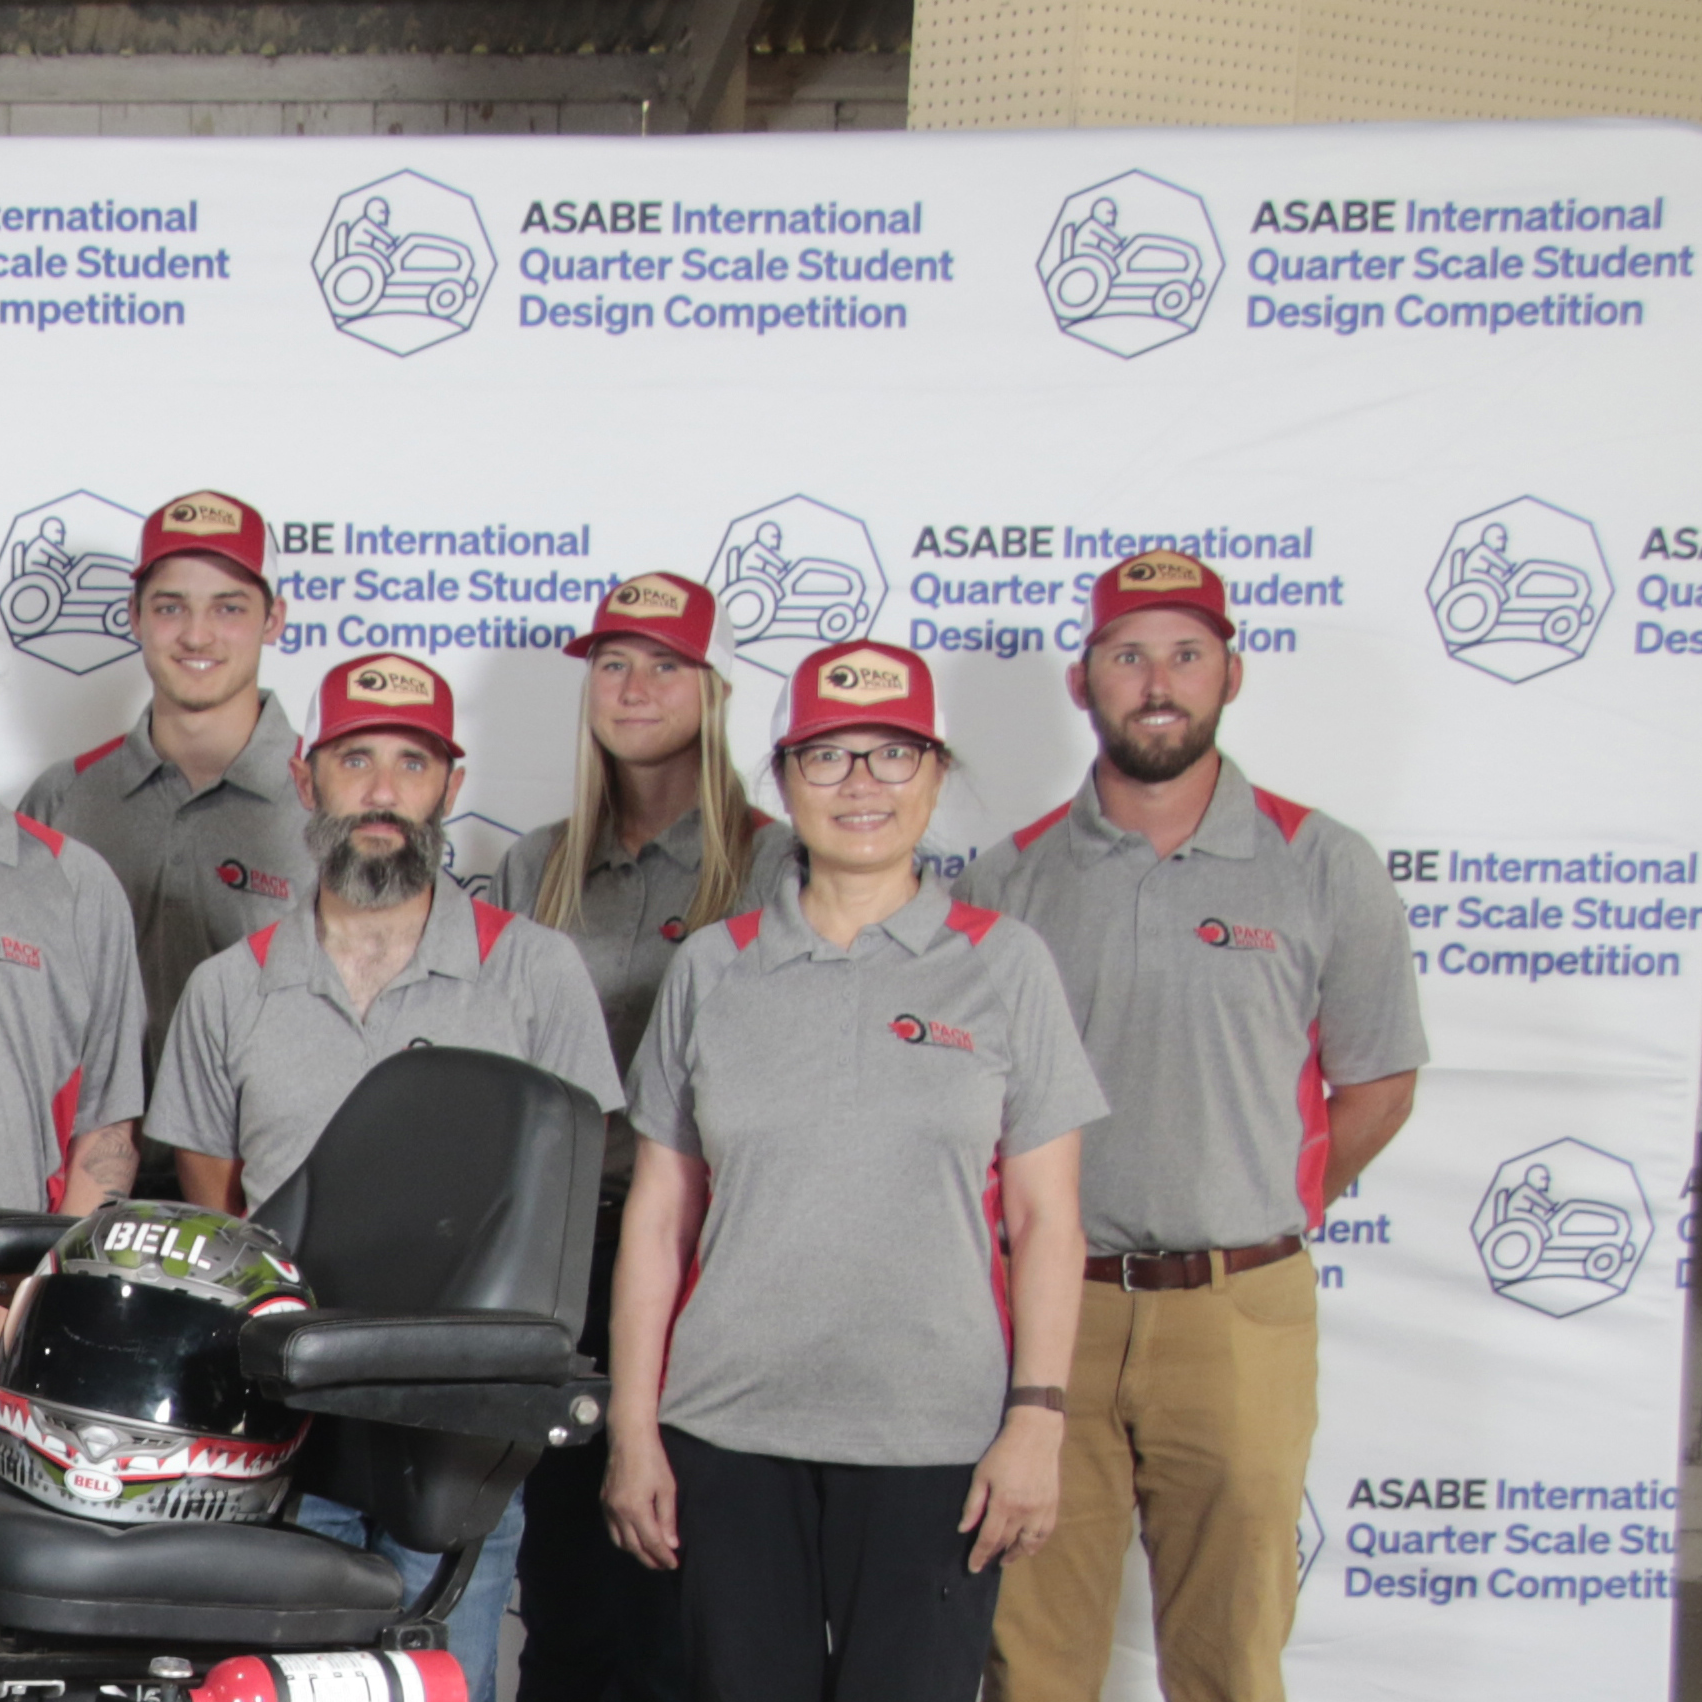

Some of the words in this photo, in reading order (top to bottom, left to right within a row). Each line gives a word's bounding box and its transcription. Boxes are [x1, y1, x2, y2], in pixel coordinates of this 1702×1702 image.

[521, 201, 662, 234] ASABE
[673, 202, 921, 234] International
[1251, 200, 1396, 233] ASABE
[1407, 197, 1663, 232] International
[76, 245, 230, 279] Student
[520, 247, 673, 285] Quarter
[681, 248, 789, 281] Scale
[797, 248, 954, 281] Student
[1248, 247, 1405, 286] Quarter
[1413, 246, 1524, 280] Scale
[1532, 245, 1694, 279] Student
[520, 294, 654, 336] Design
[664, 294, 906, 335] Competition
[1247, 295, 1384, 336] Design
[1395, 292, 1643, 334] Competition
[345, 523, 590, 556] International
[911, 526, 1054, 559] ASABE
[1063, 526, 1313, 559] International
[354, 569, 459, 602] Scale
[909, 571, 1064, 608] Quarter
[1230, 573, 1344, 606] udent
[337, 615, 577, 655] Competition
[909, 618, 1044, 661] Design
[389, 673, 426, 689] PACK
[860, 668, 900, 681] PACK
[1448, 850, 1698, 884] International
[1456, 895, 1563, 930] Scale
[1232, 925, 1274, 939] PACK
[1437, 941, 1680, 983] Competition
[103, 1221, 212, 1270] BELL
[72, 1474, 112, 1493] BELL
[1347, 1478, 1488, 1511] ASABE
[1345, 1522, 1496, 1558] Quarter
[1504, 1521, 1608, 1556] Scale
[1344, 1567, 1477, 1606] Design
[1486, 1565, 1675, 1606] Competiti
